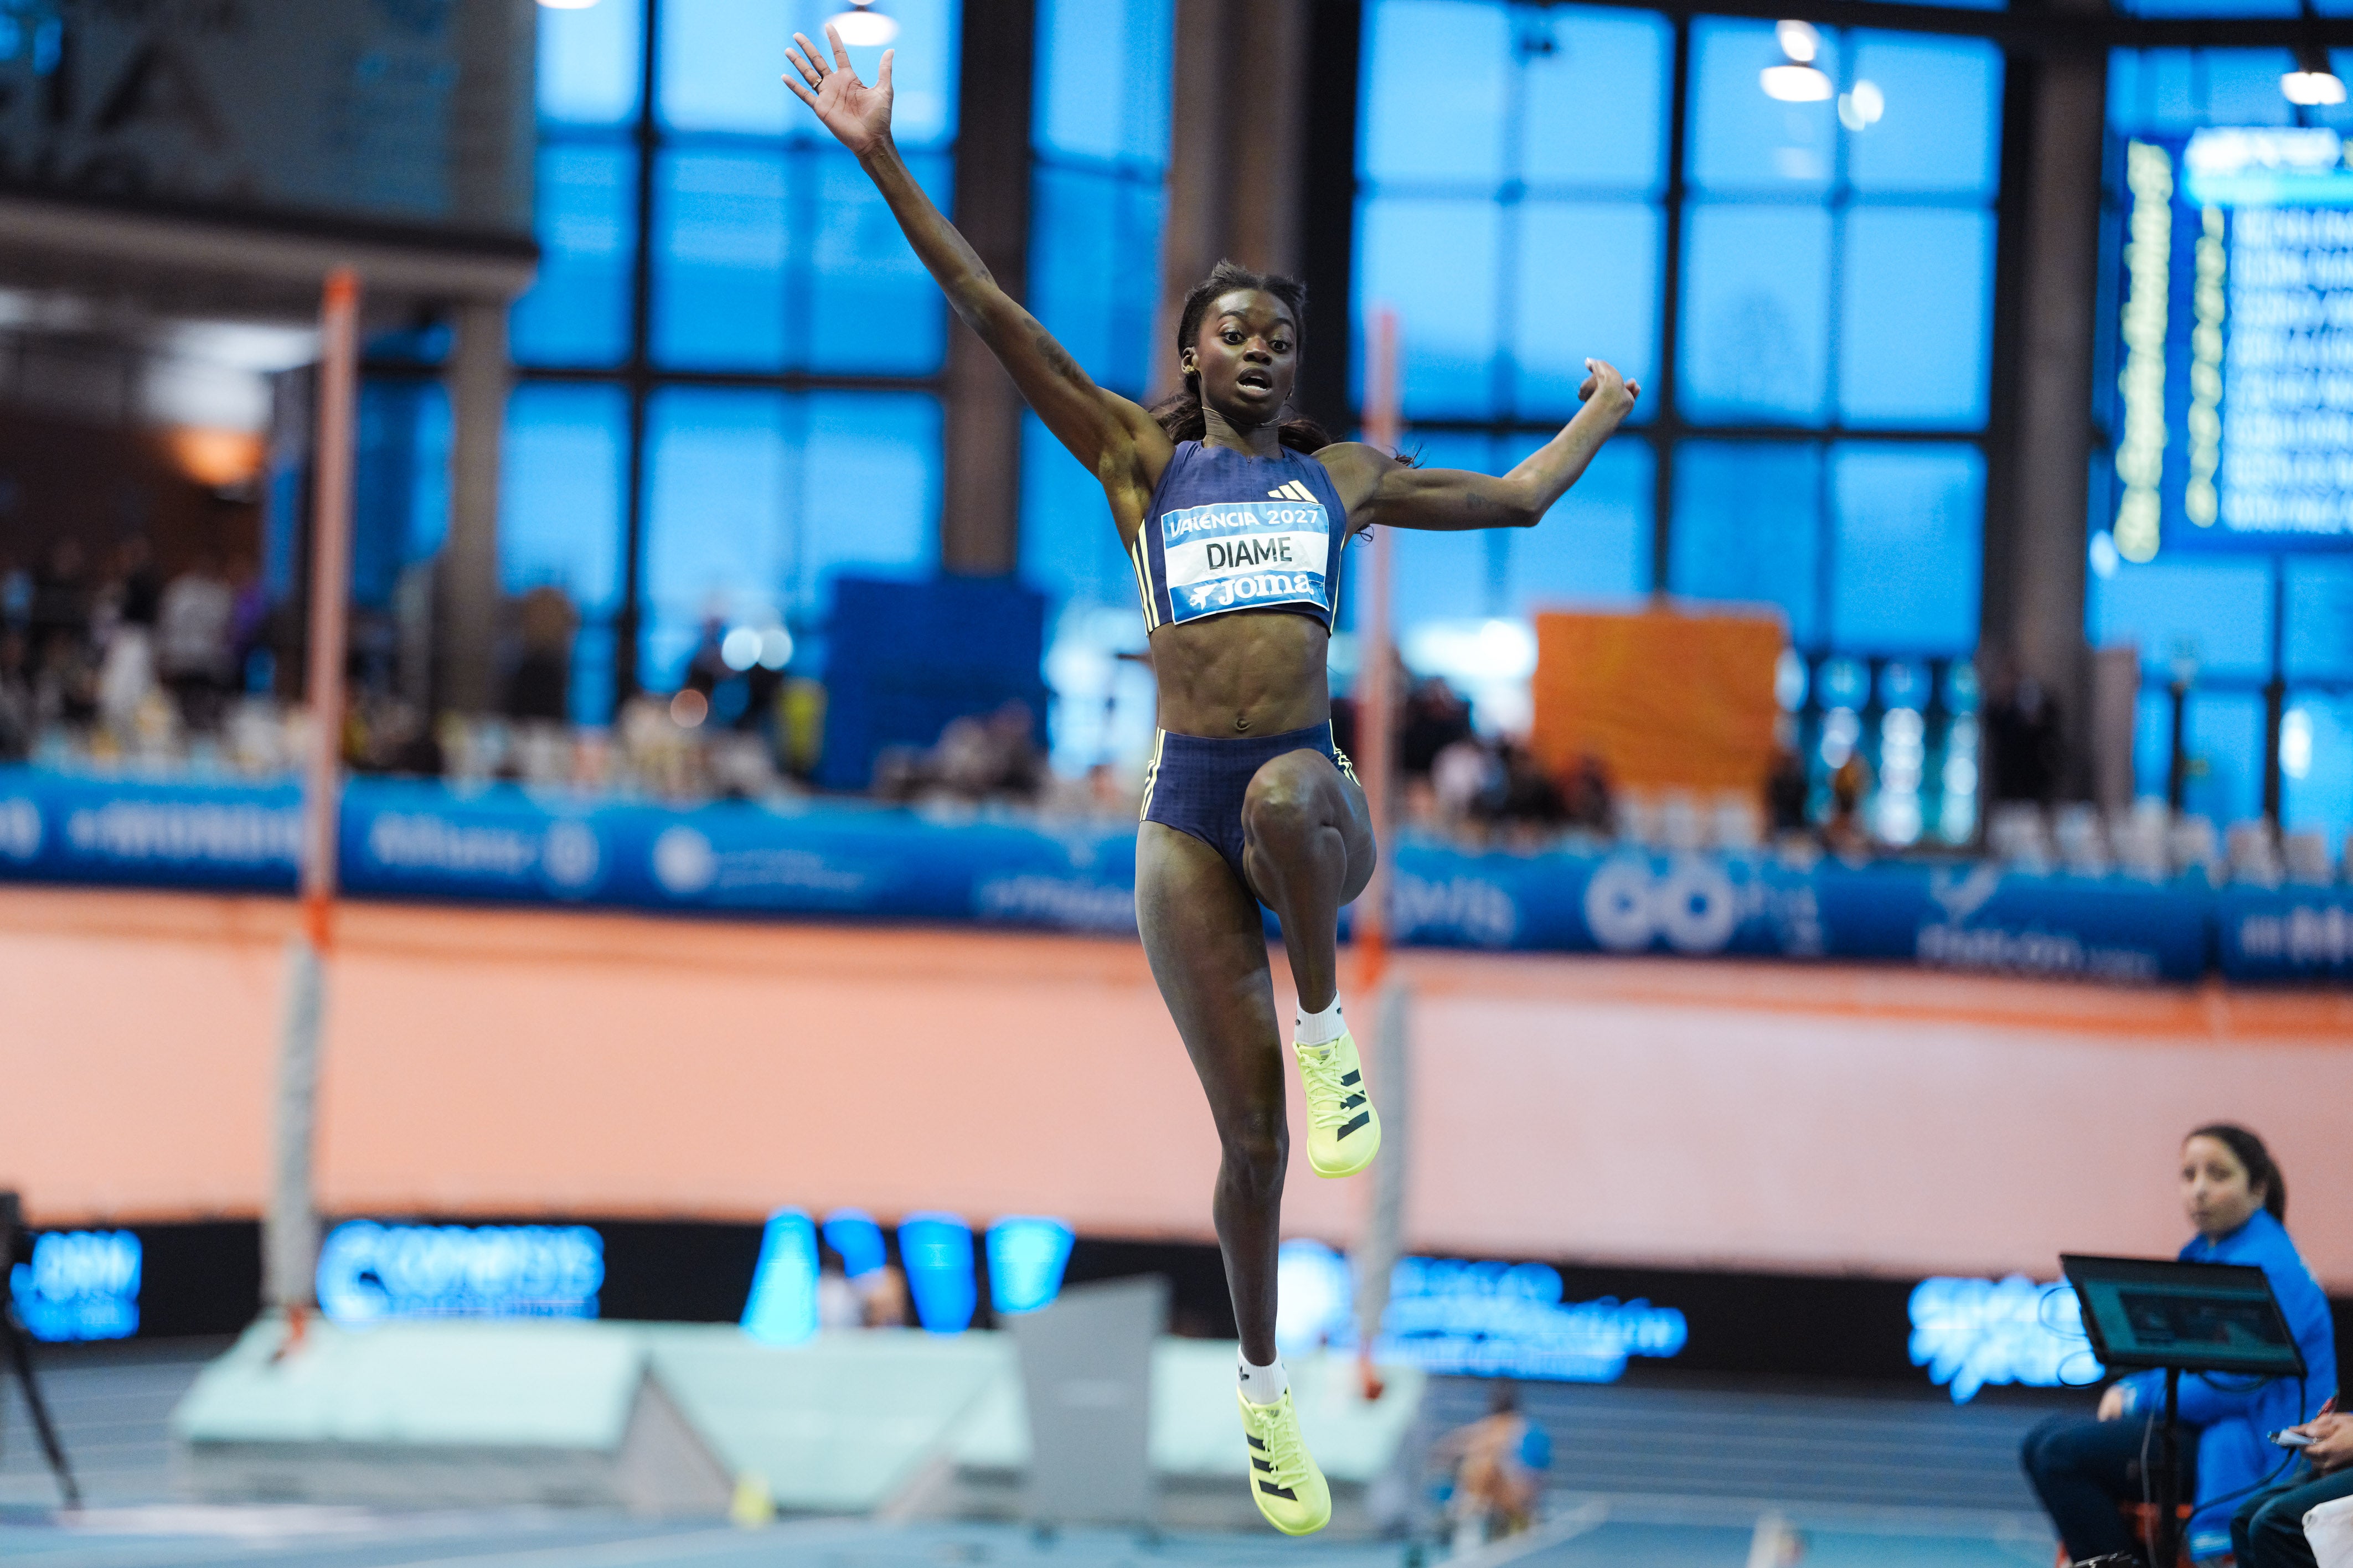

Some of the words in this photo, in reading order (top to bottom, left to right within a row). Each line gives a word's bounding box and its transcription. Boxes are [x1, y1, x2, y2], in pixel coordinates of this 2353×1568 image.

[1170, 511, 1260, 537] VALENCIA
[1267, 510, 1318, 525] 2027
[1206, 536, 1292, 570] DIAME
